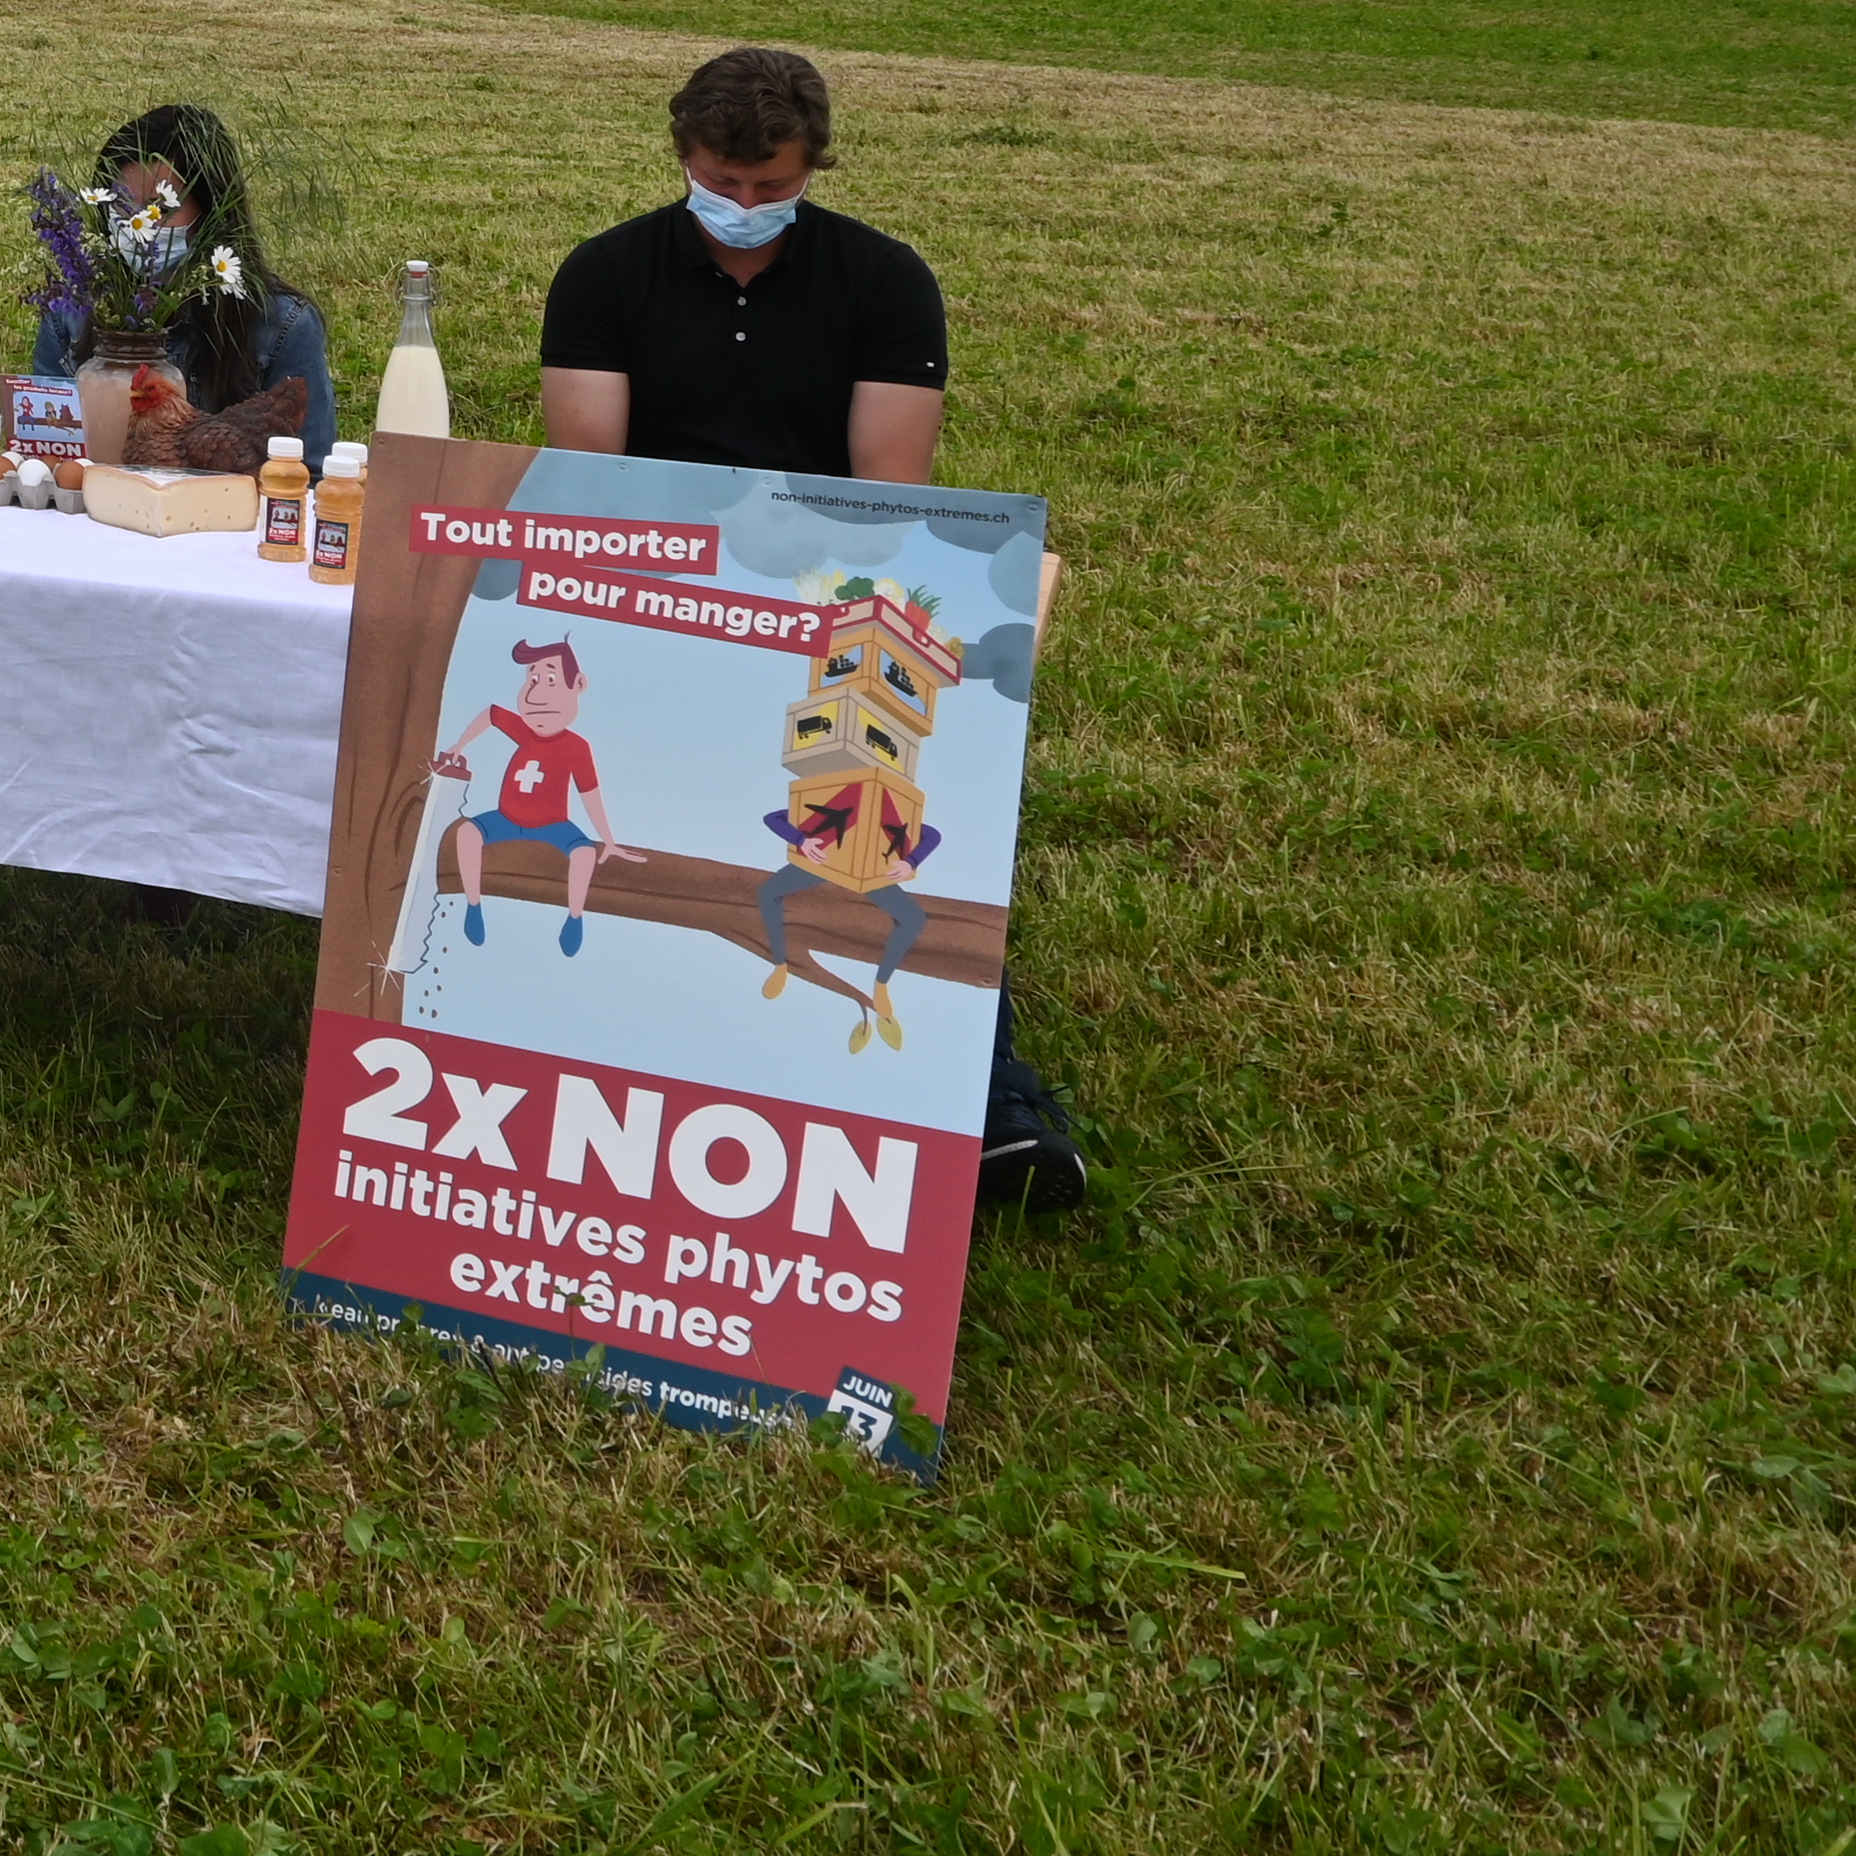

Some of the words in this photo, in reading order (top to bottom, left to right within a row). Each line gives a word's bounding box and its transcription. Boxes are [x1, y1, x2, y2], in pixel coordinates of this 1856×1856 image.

[9, 439, 33, 453] 2x
[35, 441, 83, 457] NON
[420, 512, 513, 547] Tout
[524, 518, 707, 562] importer
[770, 491, 1011, 525] non-initiatives-phytos-extremes.ch
[528, 571, 627, 609] pour
[635, 589, 821, 642] manger?
[342, 1037, 529, 1171] 2x
[546, 1073, 919, 1254] NON
[334, 1149, 647, 1264] initiatives
[664, 1231, 904, 1322] phytos
[450, 1252, 753, 1356] extrêmes
[842, 1374, 893, 1409] JUIN
